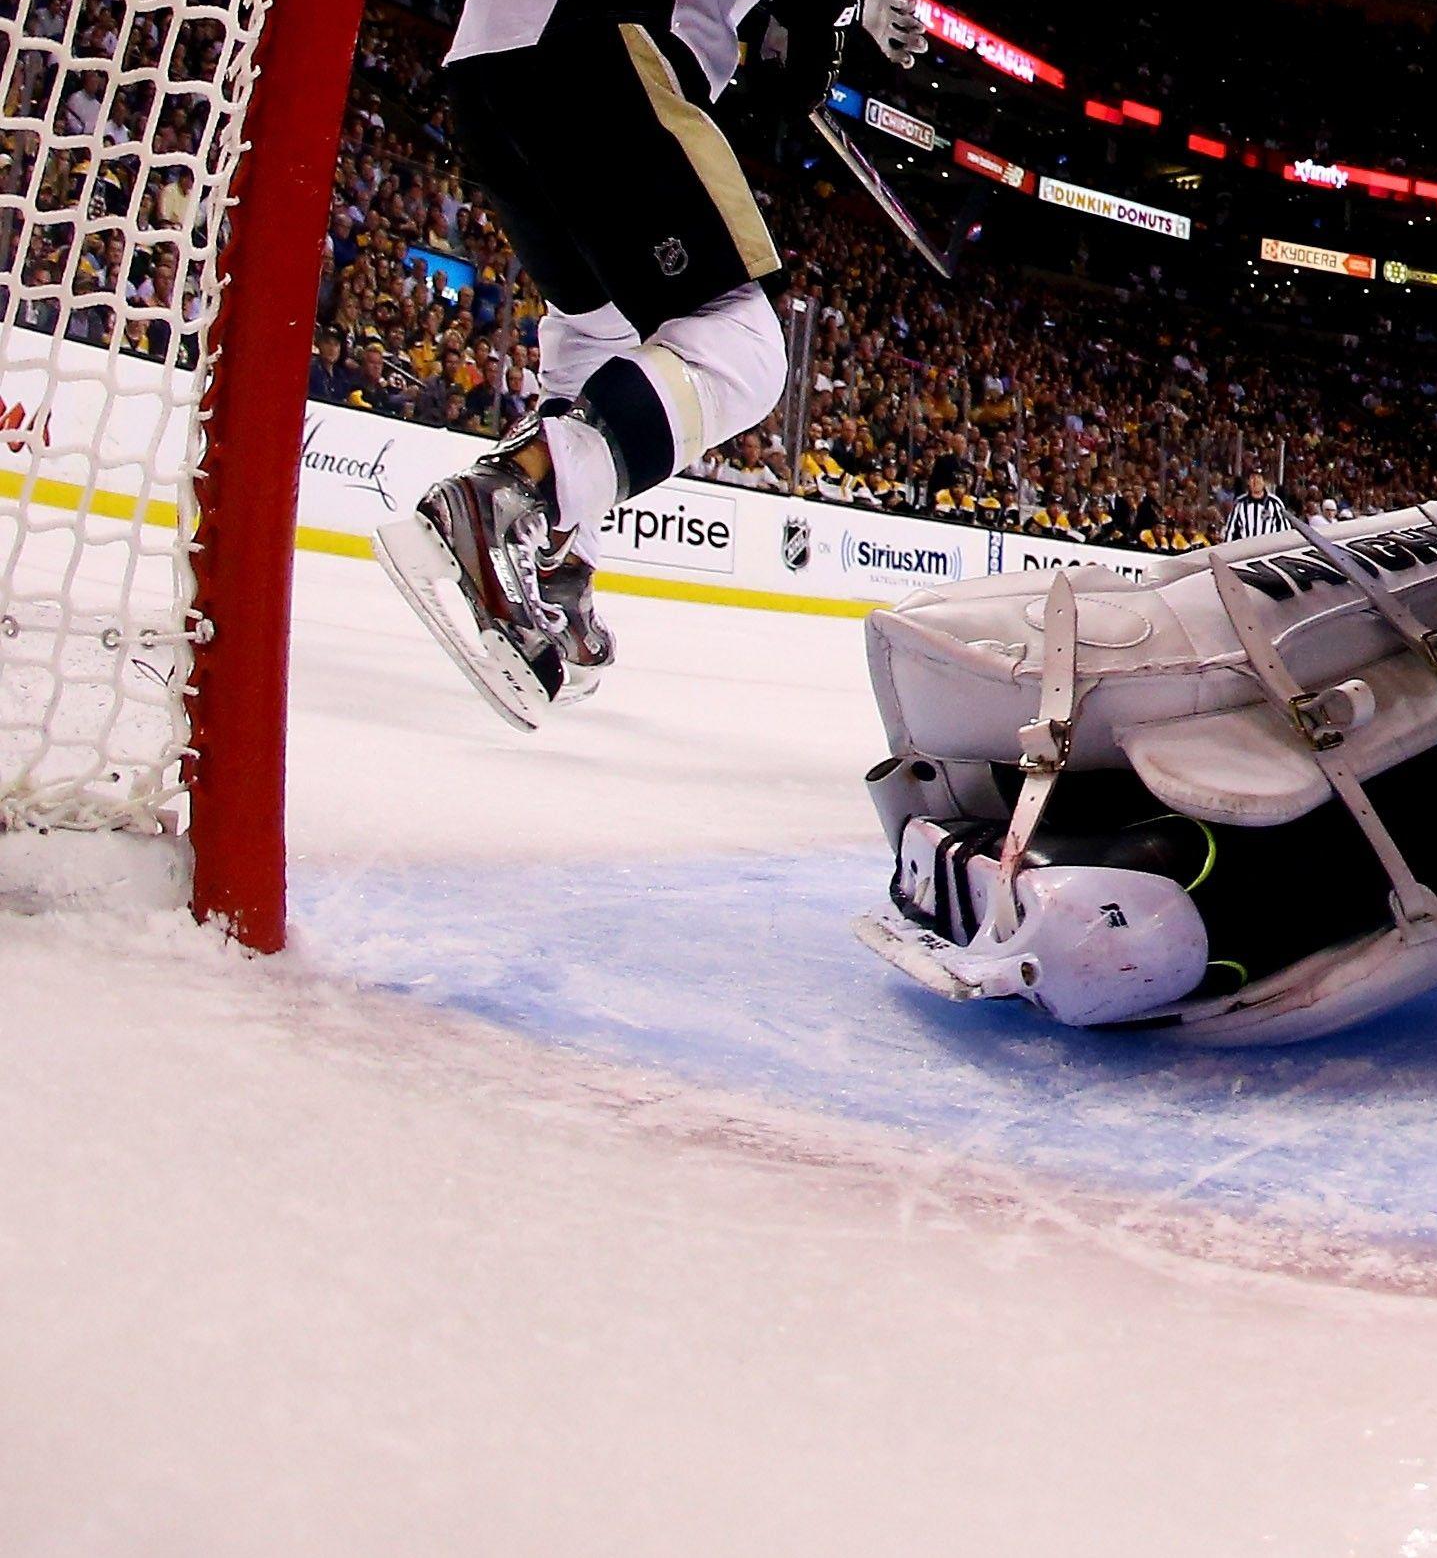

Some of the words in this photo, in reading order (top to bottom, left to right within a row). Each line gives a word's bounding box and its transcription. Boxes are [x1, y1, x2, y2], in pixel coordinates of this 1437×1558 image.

[942, 13, 976, 50] THIS
[975, 34, 1035, 83] SEASON
[1294, 158, 1348, 189] xfinity
[1054, 186, 1117, 217] DUNKIN'
[1117, 205, 1173, 233] DONUTS
[600, 505, 730, 549] erprise
